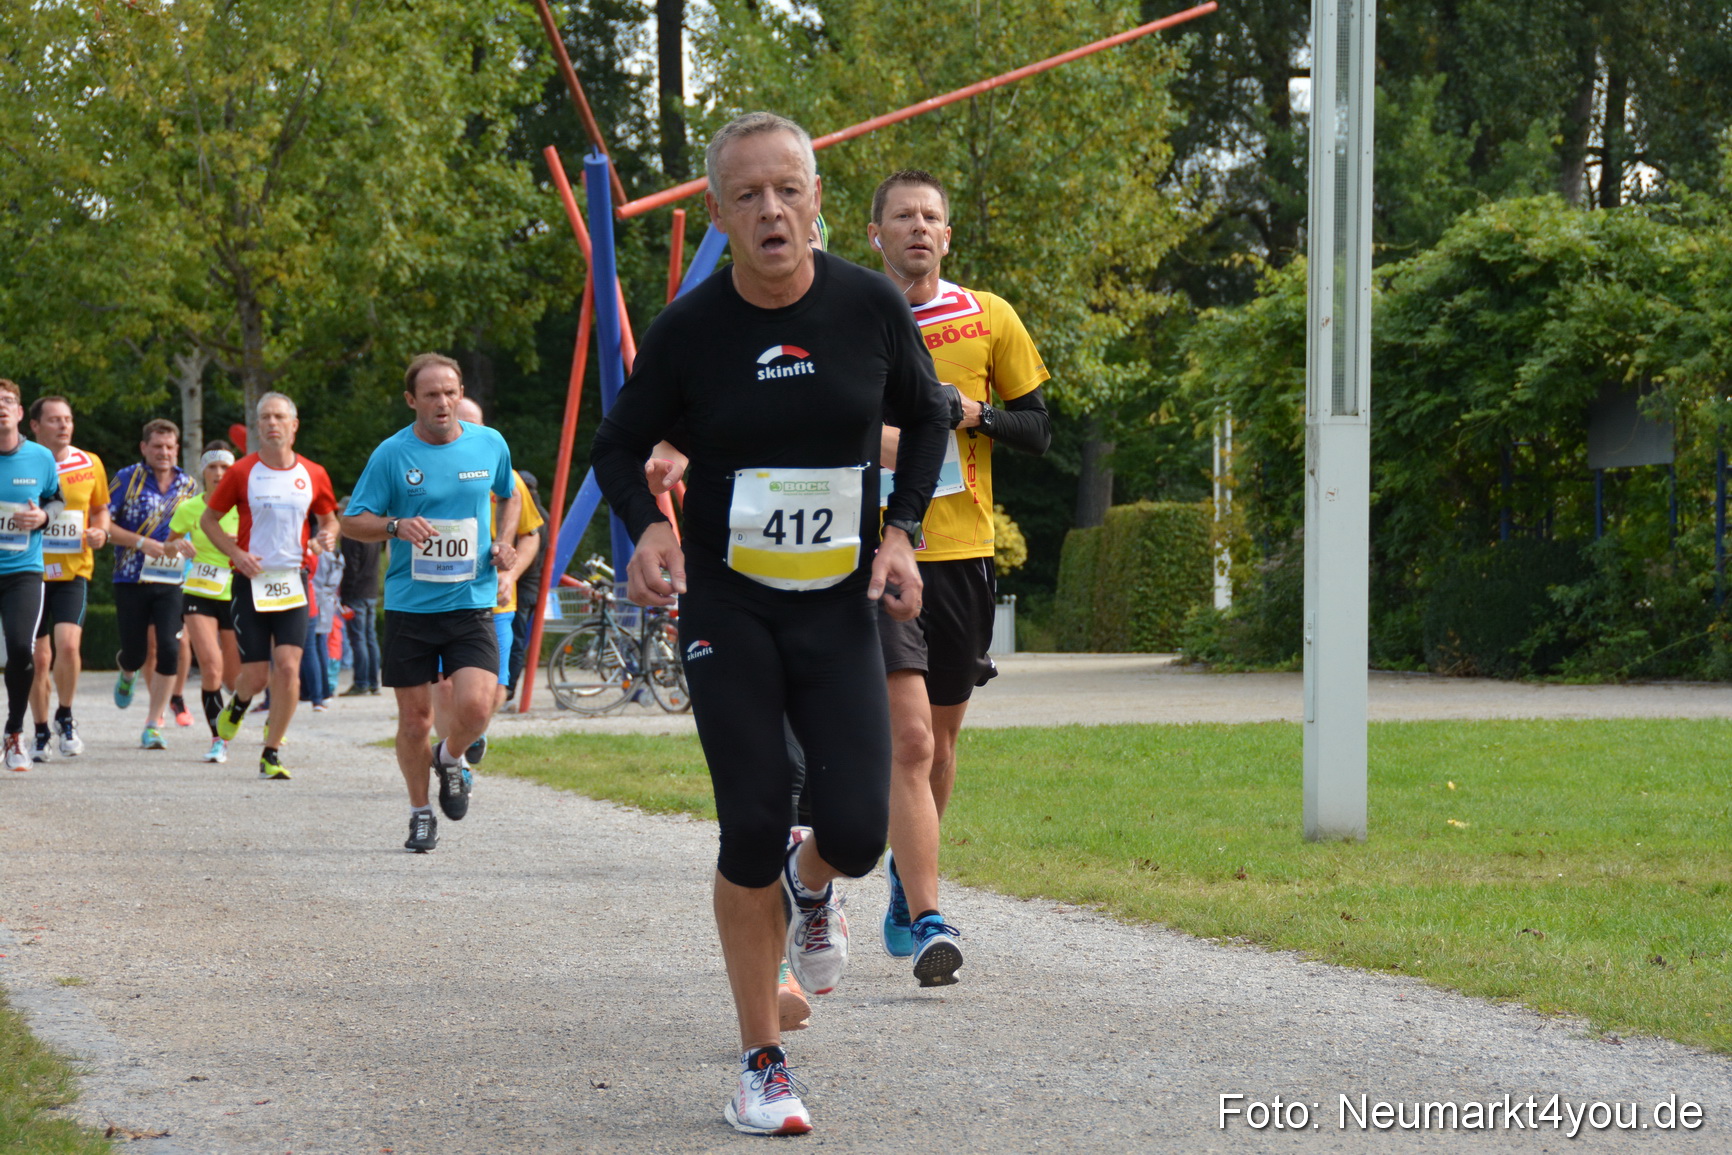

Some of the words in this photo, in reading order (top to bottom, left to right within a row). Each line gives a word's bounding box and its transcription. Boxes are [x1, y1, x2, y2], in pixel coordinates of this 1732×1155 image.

[924, 321, 990, 350] BÖGL
[757, 361, 815, 380] skinfit
[459, 470, 489, 480] BOCK
[784, 482, 830, 491] BOCK
[43, 523, 76, 536] 2618
[763, 508, 833, 545] 412
[422, 538, 468, 557] 2100
[197, 564, 218, 578] 194
[264, 582, 291, 597] 295
[687, 647, 714, 661] skinfit
